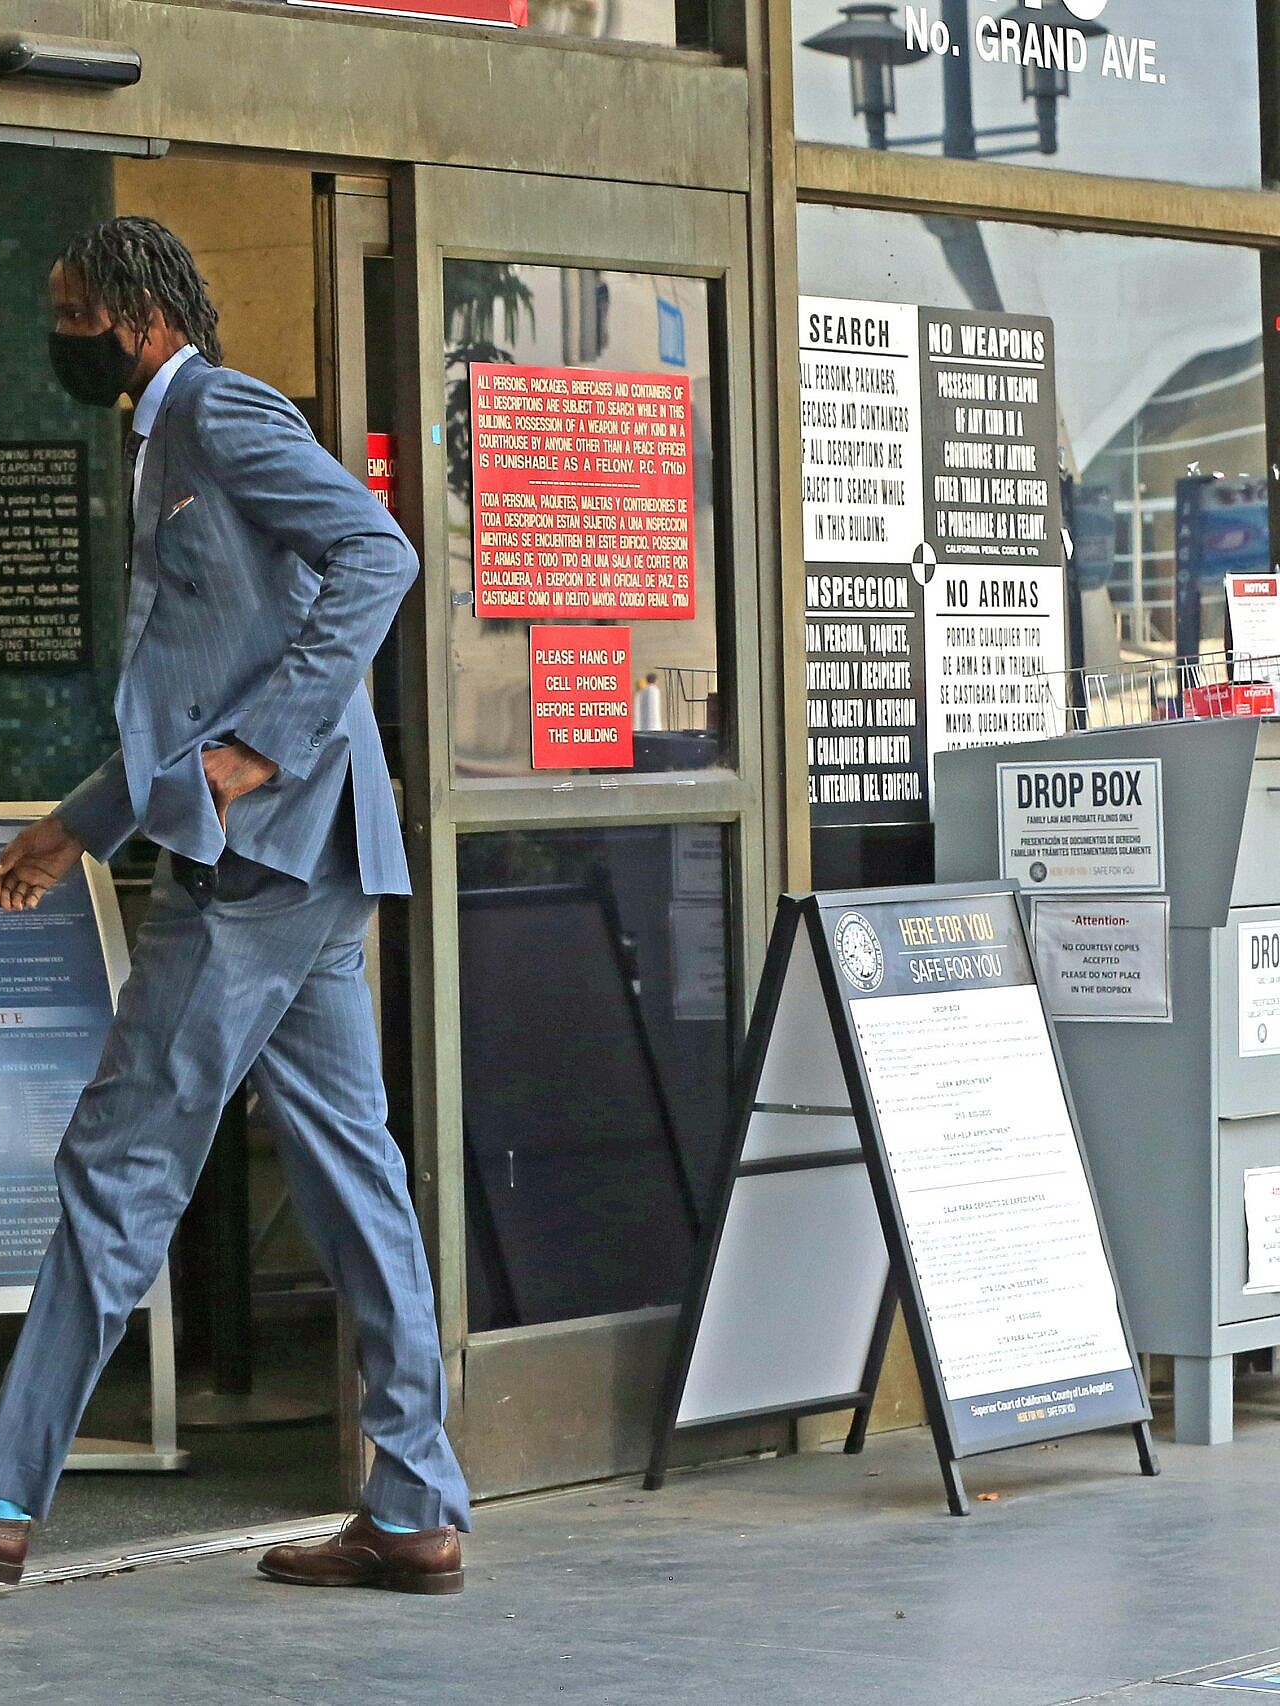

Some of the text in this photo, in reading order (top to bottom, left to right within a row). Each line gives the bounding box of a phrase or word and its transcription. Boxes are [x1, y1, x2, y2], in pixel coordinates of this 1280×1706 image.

[904, 6, 1167, 84] No. GRAND AVE.
[809, 313, 888, 347] SEARCH
[928, 322, 1044, 360] NO WEAPONS
[50, 462, 76, 472] INTO
[479, 453, 489, 467] IS
[494, 453, 558, 470] PUNISHABLE
[563, 456, 578, 471] AS
[583, 457, 591, 471] A
[595, 457, 634, 472] FELONY.
[639, 459, 656, 474] P.C.
[815, 514, 823, 539] IN
[827, 514, 844, 540] THIS
[806, 575, 909, 608] NSPECCION
[946, 579, 1038, 607] NO ARMAS
[535, 649, 625, 664] PLEASE HANG UP
[545, 675, 617, 690] CELL PHONES
[536, 701, 627, 716] BEFORE ENTERING
[548, 727, 617, 742] THE BUILDING
[1017, 770, 1142, 808] DROP BOX
[898, 912, 994, 946] HERE FOR YOU
[1062, 943, 1139, 951] NO COURTESY COPIES
[1251, 933, 1280, 969] DRO
[909, 953, 1002, 984] SAFE FOR YOU
[1082, 956, 1119, 964] ACCEPTED
[1061, 970, 1086, 978] PLEASE
[1119, 971, 1140, 979] PLACE
[1080, 985, 1094, 993] THE
[1096, 985, 1131, 993] DROPBOX
